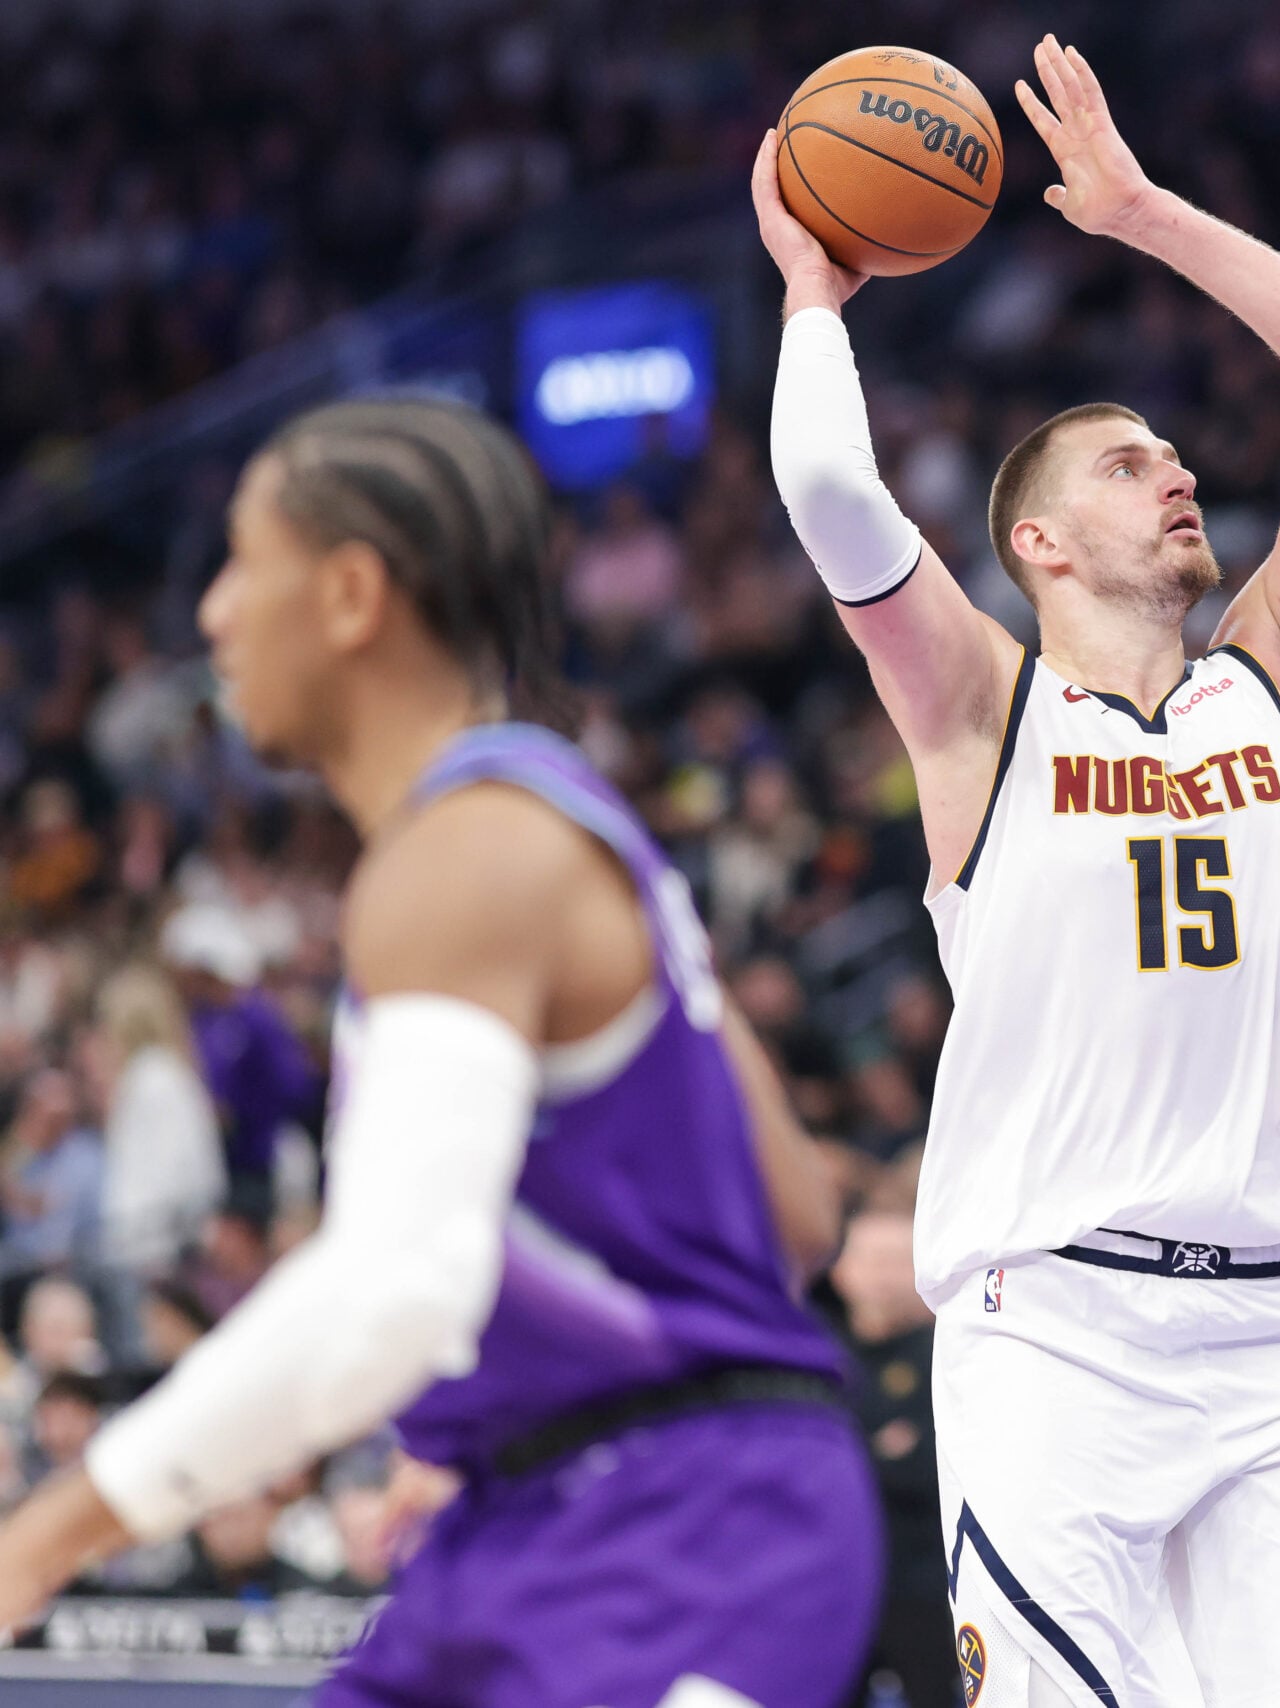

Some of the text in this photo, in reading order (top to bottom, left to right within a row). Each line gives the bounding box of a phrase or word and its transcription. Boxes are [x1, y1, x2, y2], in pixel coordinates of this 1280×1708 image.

[859, 90, 989, 186] Wilson
[1170, 678, 1234, 717] ibotta
[1126, 835, 1242, 972] 15
